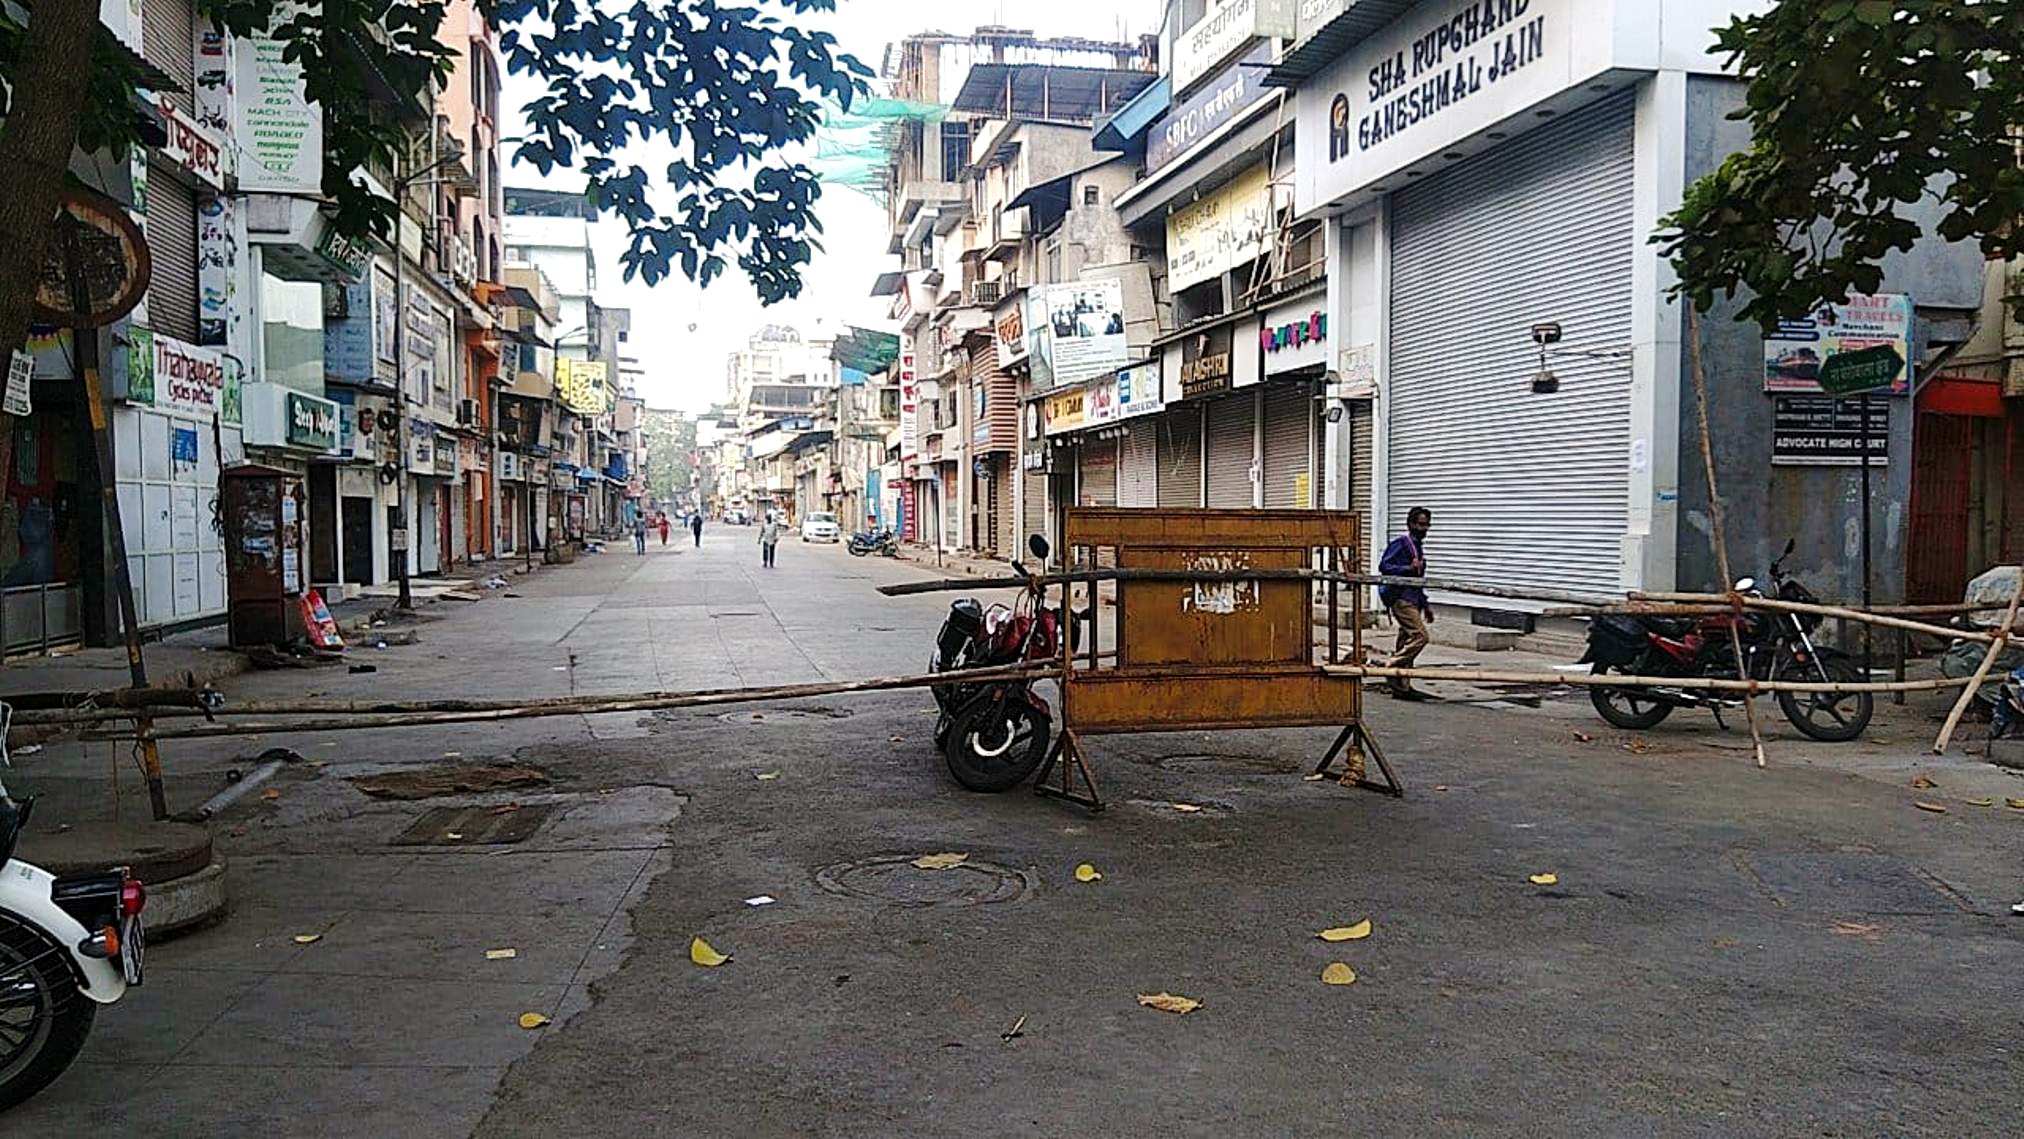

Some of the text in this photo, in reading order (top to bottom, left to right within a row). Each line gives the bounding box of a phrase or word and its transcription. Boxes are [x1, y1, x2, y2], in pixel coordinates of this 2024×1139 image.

[1358, 16, 1545, 151] GANESHMAL JAIN
[1368, 52, 1406, 103] SHA
[247, 107, 281, 116] MACH
[1166, 109, 1199, 150] SBFC
[1776, 437, 1886, 449] ADVOCATE HIGH CURT
